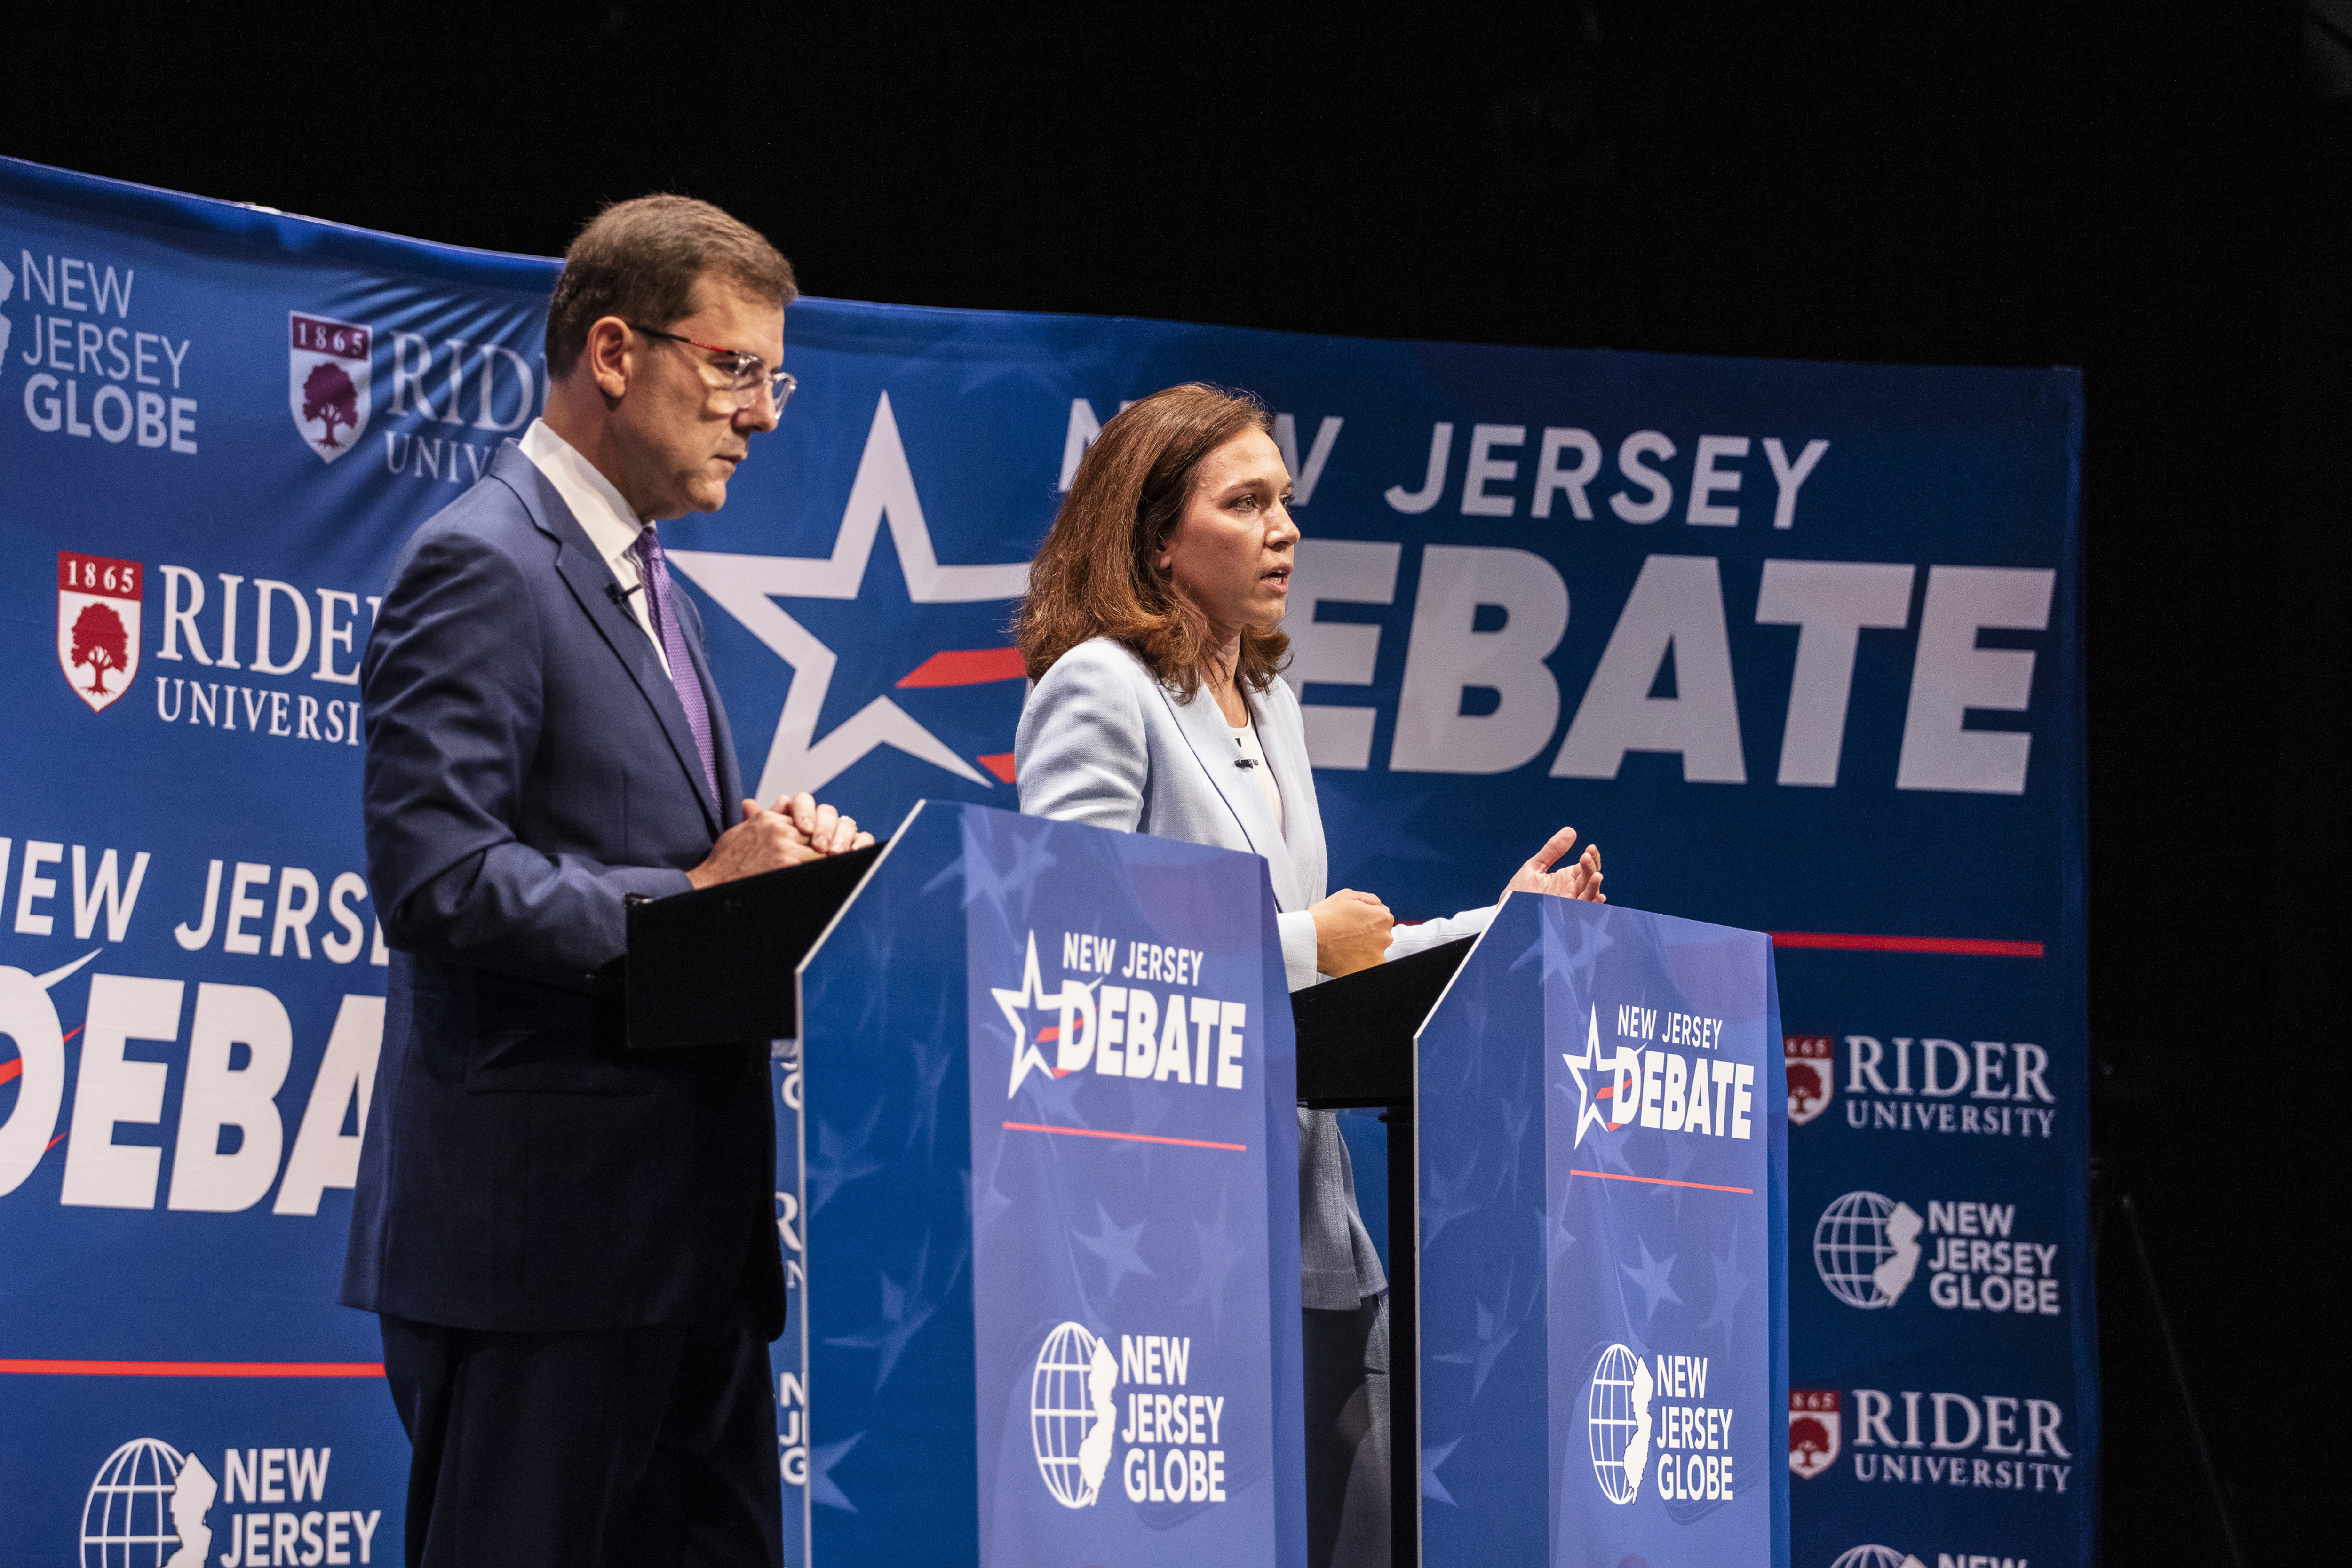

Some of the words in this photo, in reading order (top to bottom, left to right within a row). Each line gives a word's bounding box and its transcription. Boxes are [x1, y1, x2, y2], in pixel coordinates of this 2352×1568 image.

[22, 249, 134, 318] NEW
[22, 314, 190, 389] JERSEY
[298, 322, 363, 356] 1865
[385, 331, 551, 432] RID
[24, 373, 198, 454] GLOBE
[1384, 422, 1830, 529] JERSEY
[67, 559, 135, 593] 1865
[1287, 537, 2056, 795] EBATE
[156, 676, 361, 746] UNIVERSI
[0, 836, 151, 943] EW
[174, 859, 389, 966] JERS
[1063, 932, 1116, 974] NEW
[1122, 941, 1204, 986] JERSEY
[1057, 979, 1246, 1089] DEBATE
[1617, 1004, 1657, 1040] NEW
[1662, 1012, 1723, 1050] JERSEY
[1786, 1038, 1827, 1056] 865
[1611, 1045, 1754, 1140] DEBATE
[1845, 1035, 2056, 1104] RIDER
[1845, 1100, 2056, 1138] UNIVERSITY
[1928, 1200, 2015, 1237] NEW
[1928, 1237, 2058, 1276] JERSEY
[1929, 1271, 2061, 1315] GLOBE
[1122, 1334, 1190, 1385] NEW
[1657, 1354, 1708, 1399] NEW
[1121, 1393, 1224, 1444] JERSEY
[1792, 1391, 1835, 1410] 865
[1852, 1389, 2072, 1459] RIDER
[1656, 1406, 1733, 1450] JERSEY
[224, 1447, 331, 1503] NEW
[1124, 1448, 1226, 1503] GLOBE
[1657, 1453, 1733, 1501] GLOBE
[1853, 1453, 2073, 1494] UNIVERSITY
[220, 1510, 381, 1568] JERSEY
